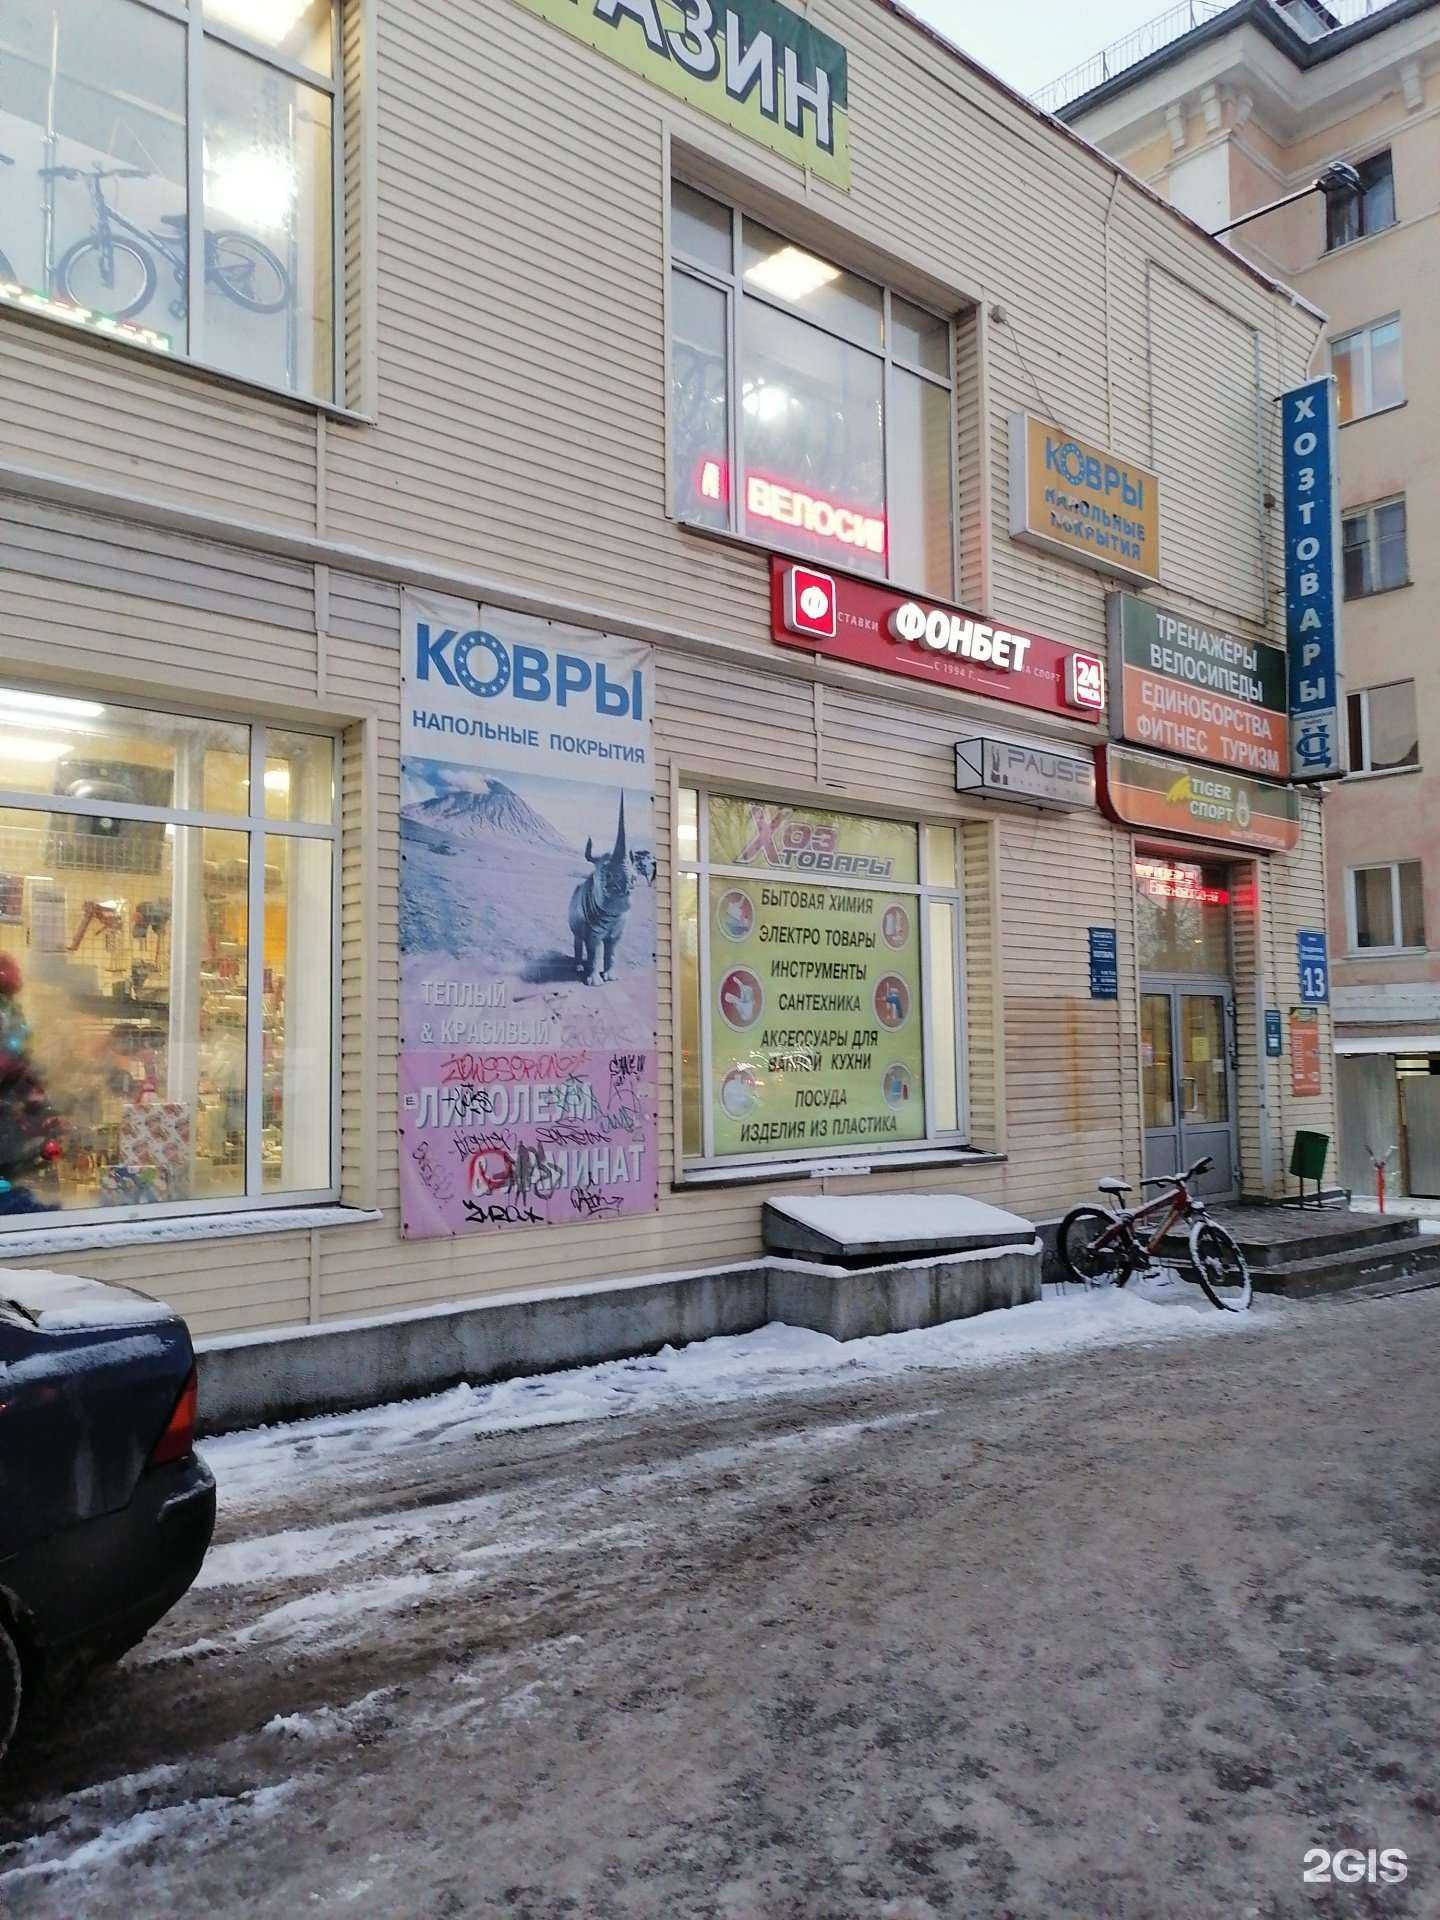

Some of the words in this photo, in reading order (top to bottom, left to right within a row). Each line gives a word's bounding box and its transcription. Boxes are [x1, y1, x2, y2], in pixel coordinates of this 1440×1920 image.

[1045, 436, 1143, 510] КОВРЫ
[1293, 395, 1326, 702] ХОЗТОВАРЫ
[838, 612, 879, 631] СТАВКИ
[896, 601, 1031, 672] ФОНБЕТ
[1156, 613, 1258, 672] ТРЕНАЖЁРЫ
[416, 622, 643, 721] КОВРЫ
[944, 664, 966, 676] 1994
[1077, 661, 1101, 689] 24
[1150, 643, 1264, 702] ВЕЛОСИПЕДЫ
[1142, 680, 1273, 741] ЕДИНОБОРСТВА
[412, 709, 539, 747] НАПОЛЬНЫЕ
[550, 733, 646, 764] ПОКРЫТИЯ
[1137, 714, 1209, 754] ФИТНЕС
[1220, 736, 1281, 772] ТУРИЗМ
[1007, 749, 1091, 785] PAUSE
[1191, 778, 1232, 801] TIGER
[1189, 800, 1235, 822] СПОРТ
[780, 848, 893, 878] ТОВАРЫ
[761, 888, 825, 911] БЫТОВАЯ
[829, 894, 873, 914] ХИМИЯ
[759, 925, 820, 946] ЭЛЕКТРО
[825, 929, 876, 949] ТОВАРЫ
[771, 959, 867, 981] ИНСТРУМЕНТЫ
[1303, 967, 1325, 997] 13
[421, 980, 507, 1009] ТЕПЛЫЙ
[778, 993, 861, 1011] САНТЕХНИКА
[421, 1022, 434, 1044] &
[440, 1019, 550, 1045] КРАСИВЫЙ
[760, 1030, 848, 1047] АКСЕССУАРЫ
[852, 1030, 878, 1049] ДЛЯ
[831, 1053, 872, 1070] КУХНИ
[795, 1089, 848, 1109] ПОСУДА
[741, 1120, 805, 1145] ИЗДЕЛИЯ
[810, 1119, 828, 1137] ИЗ
[832, 1115, 897, 1136] ПЛАСТИКА
